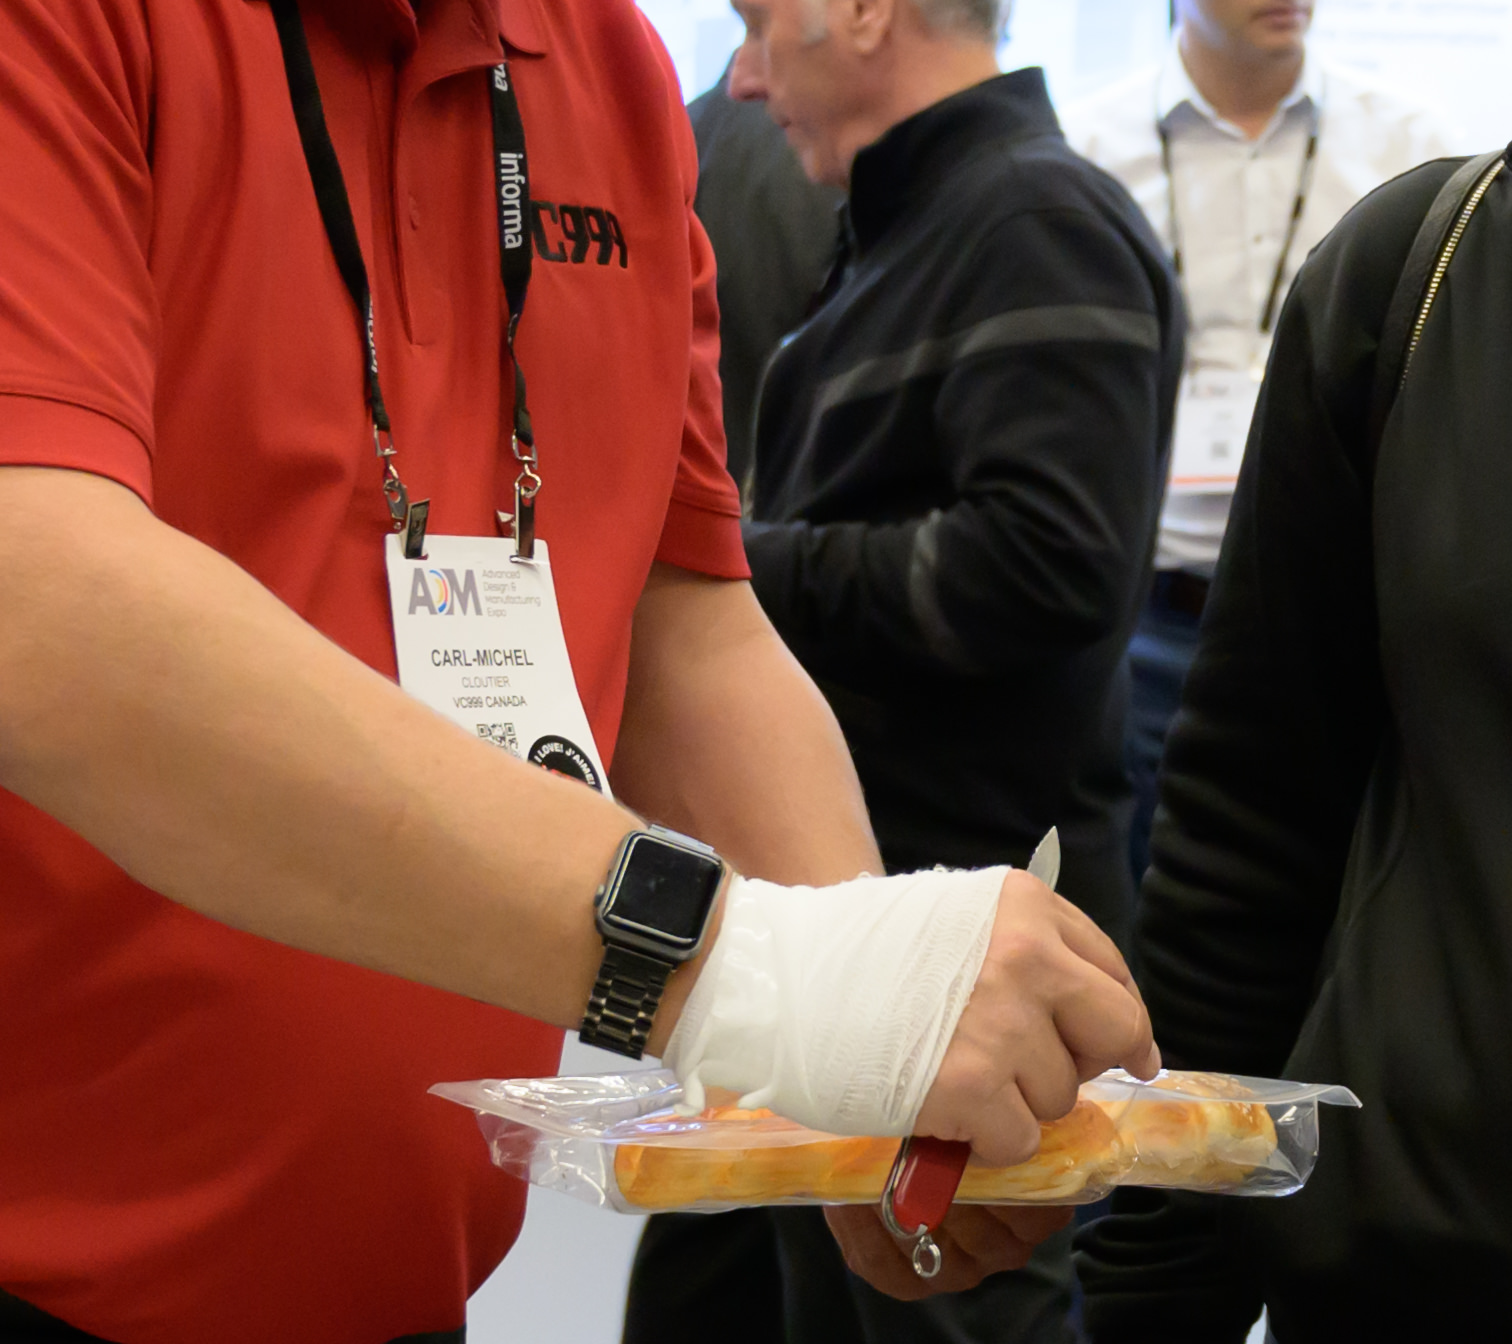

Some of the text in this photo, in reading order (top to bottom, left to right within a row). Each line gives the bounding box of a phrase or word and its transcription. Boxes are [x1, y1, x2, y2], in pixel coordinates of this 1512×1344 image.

[500, 152, 526, 249] informa
[431, 649, 534, 667] CARL-MICHEL
[461, 675, 511, 688] CLOUTIER
[452, 695, 528, 709] VC999 CANADA
[537, 742, 564, 758] LOVE!
[565, 747, 596, 785] J'AIME!
